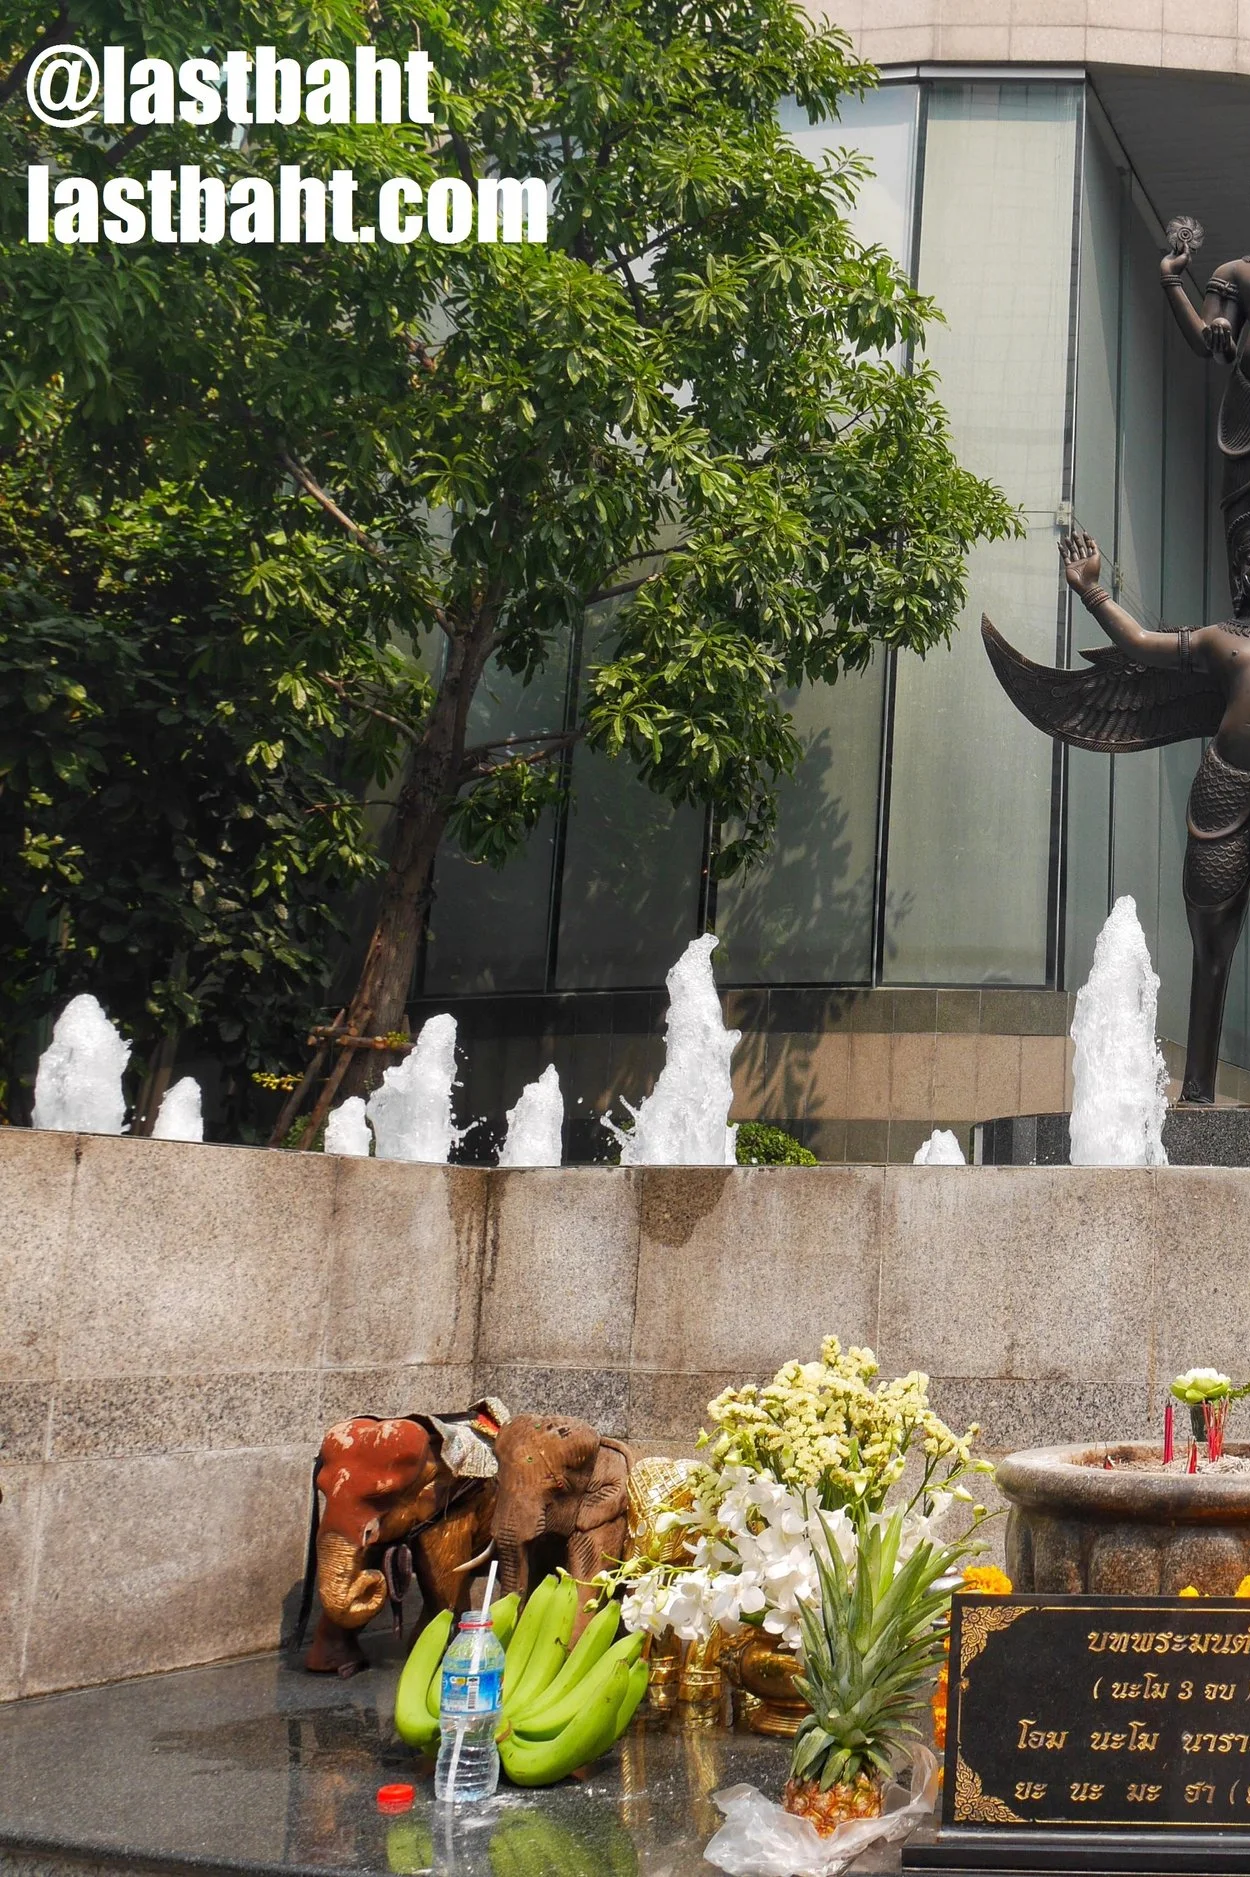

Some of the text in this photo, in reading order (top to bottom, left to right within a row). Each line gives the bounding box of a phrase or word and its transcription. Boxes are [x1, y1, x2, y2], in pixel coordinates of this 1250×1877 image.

[1177, 1681, 1193, 1700] 3
[1017, 1719, 1070, 1750] โอม
[1090, 1720, 1161, 1752] นะโม
[1014, 1780, 1048, 1802] ยะ
[1069, 1781, 1105, 1802] นะ
[1126, 1781, 1162, 1802] มะ
